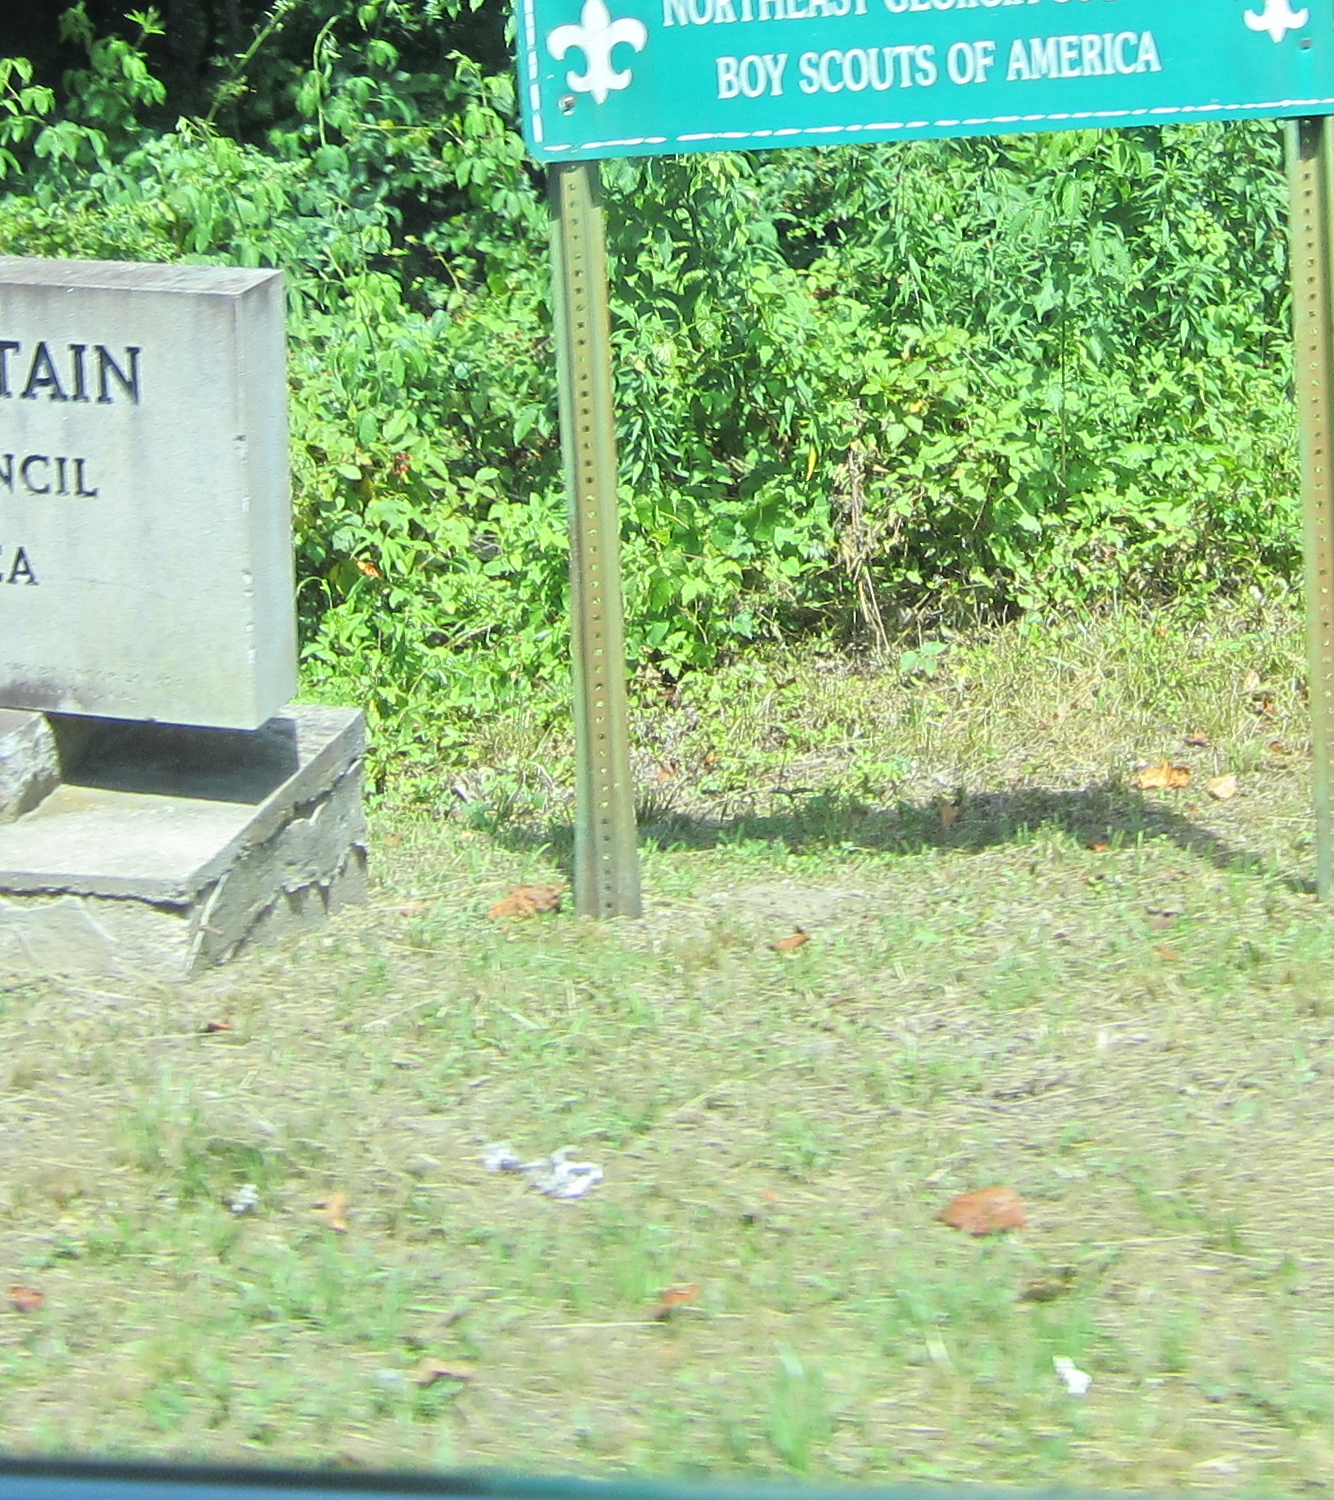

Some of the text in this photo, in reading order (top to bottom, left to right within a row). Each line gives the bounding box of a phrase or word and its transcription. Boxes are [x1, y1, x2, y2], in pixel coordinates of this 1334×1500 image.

[716, 31, 1162, 99] BOY SCOUTS OF AMERICA
